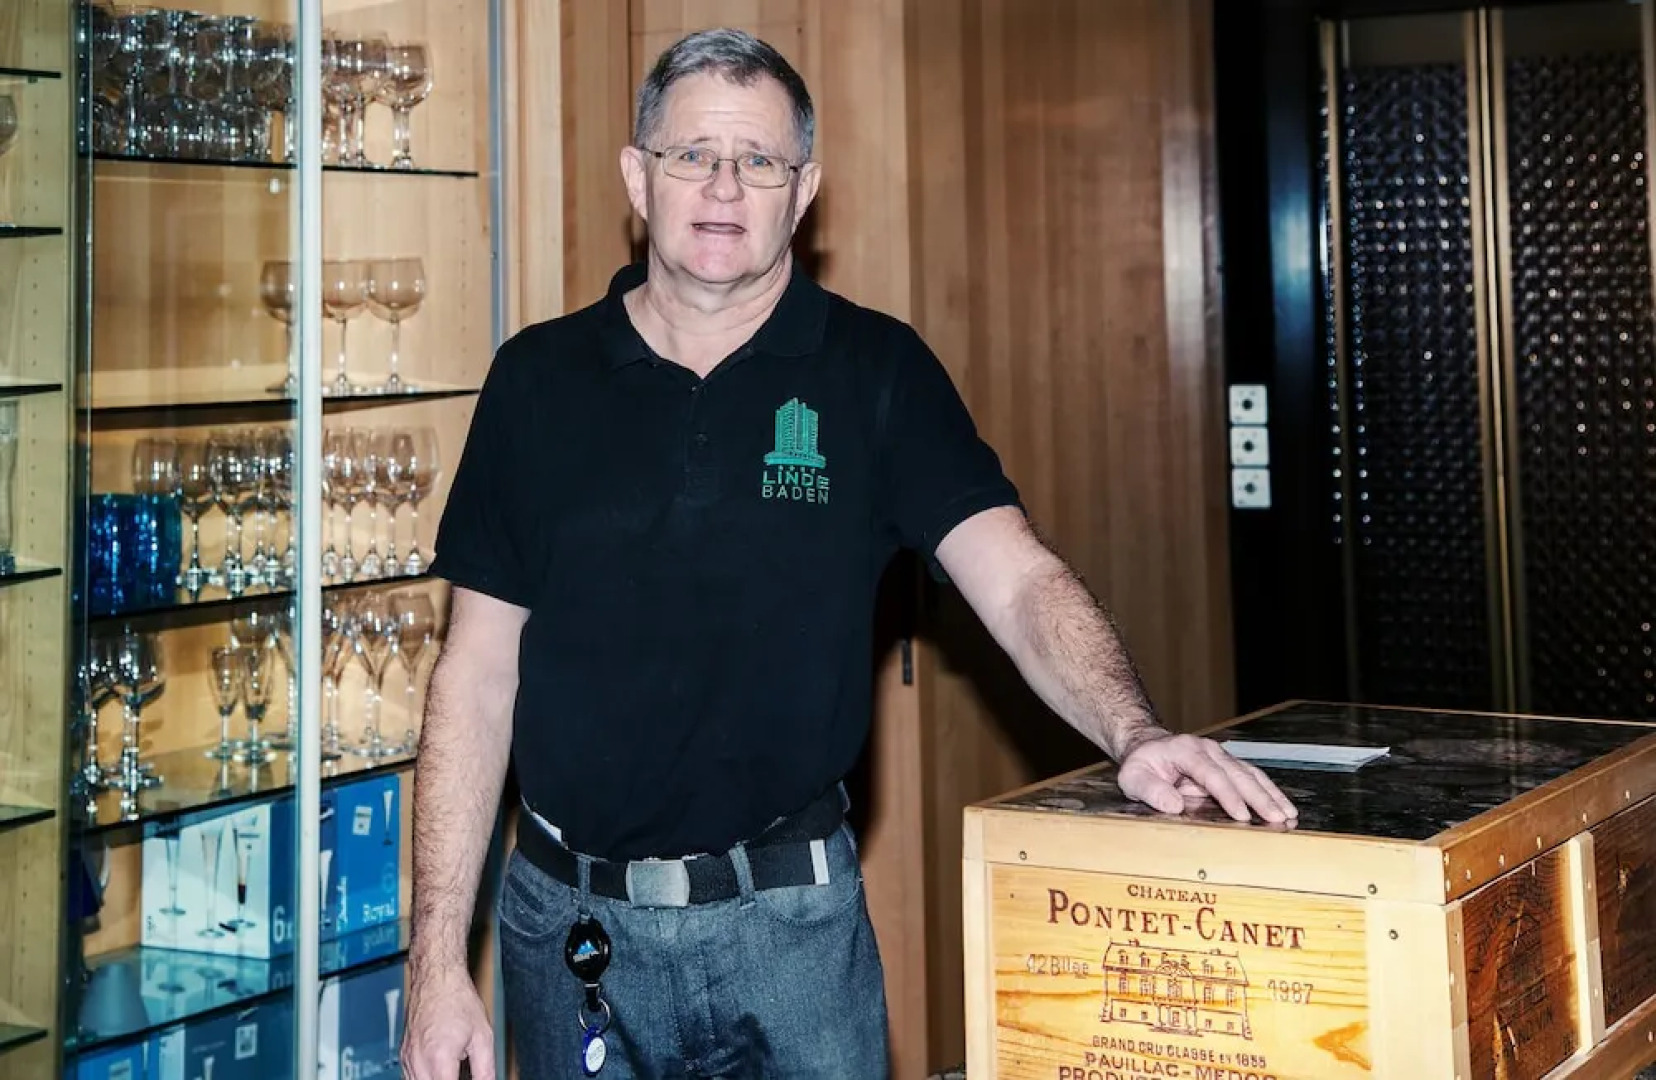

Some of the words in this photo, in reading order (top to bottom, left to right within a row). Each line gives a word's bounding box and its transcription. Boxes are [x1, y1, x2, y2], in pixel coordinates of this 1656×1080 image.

[762, 471, 830, 490] LINDE
[761, 485, 829, 504] BADEN
[1127, 884, 1218, 905] CHATEAU
[1267, 979, 1314, 1005] 1987
[1092, 1034, 1135, 1051] GRAND
[1138, 1041, 1163, 1056] CRU
